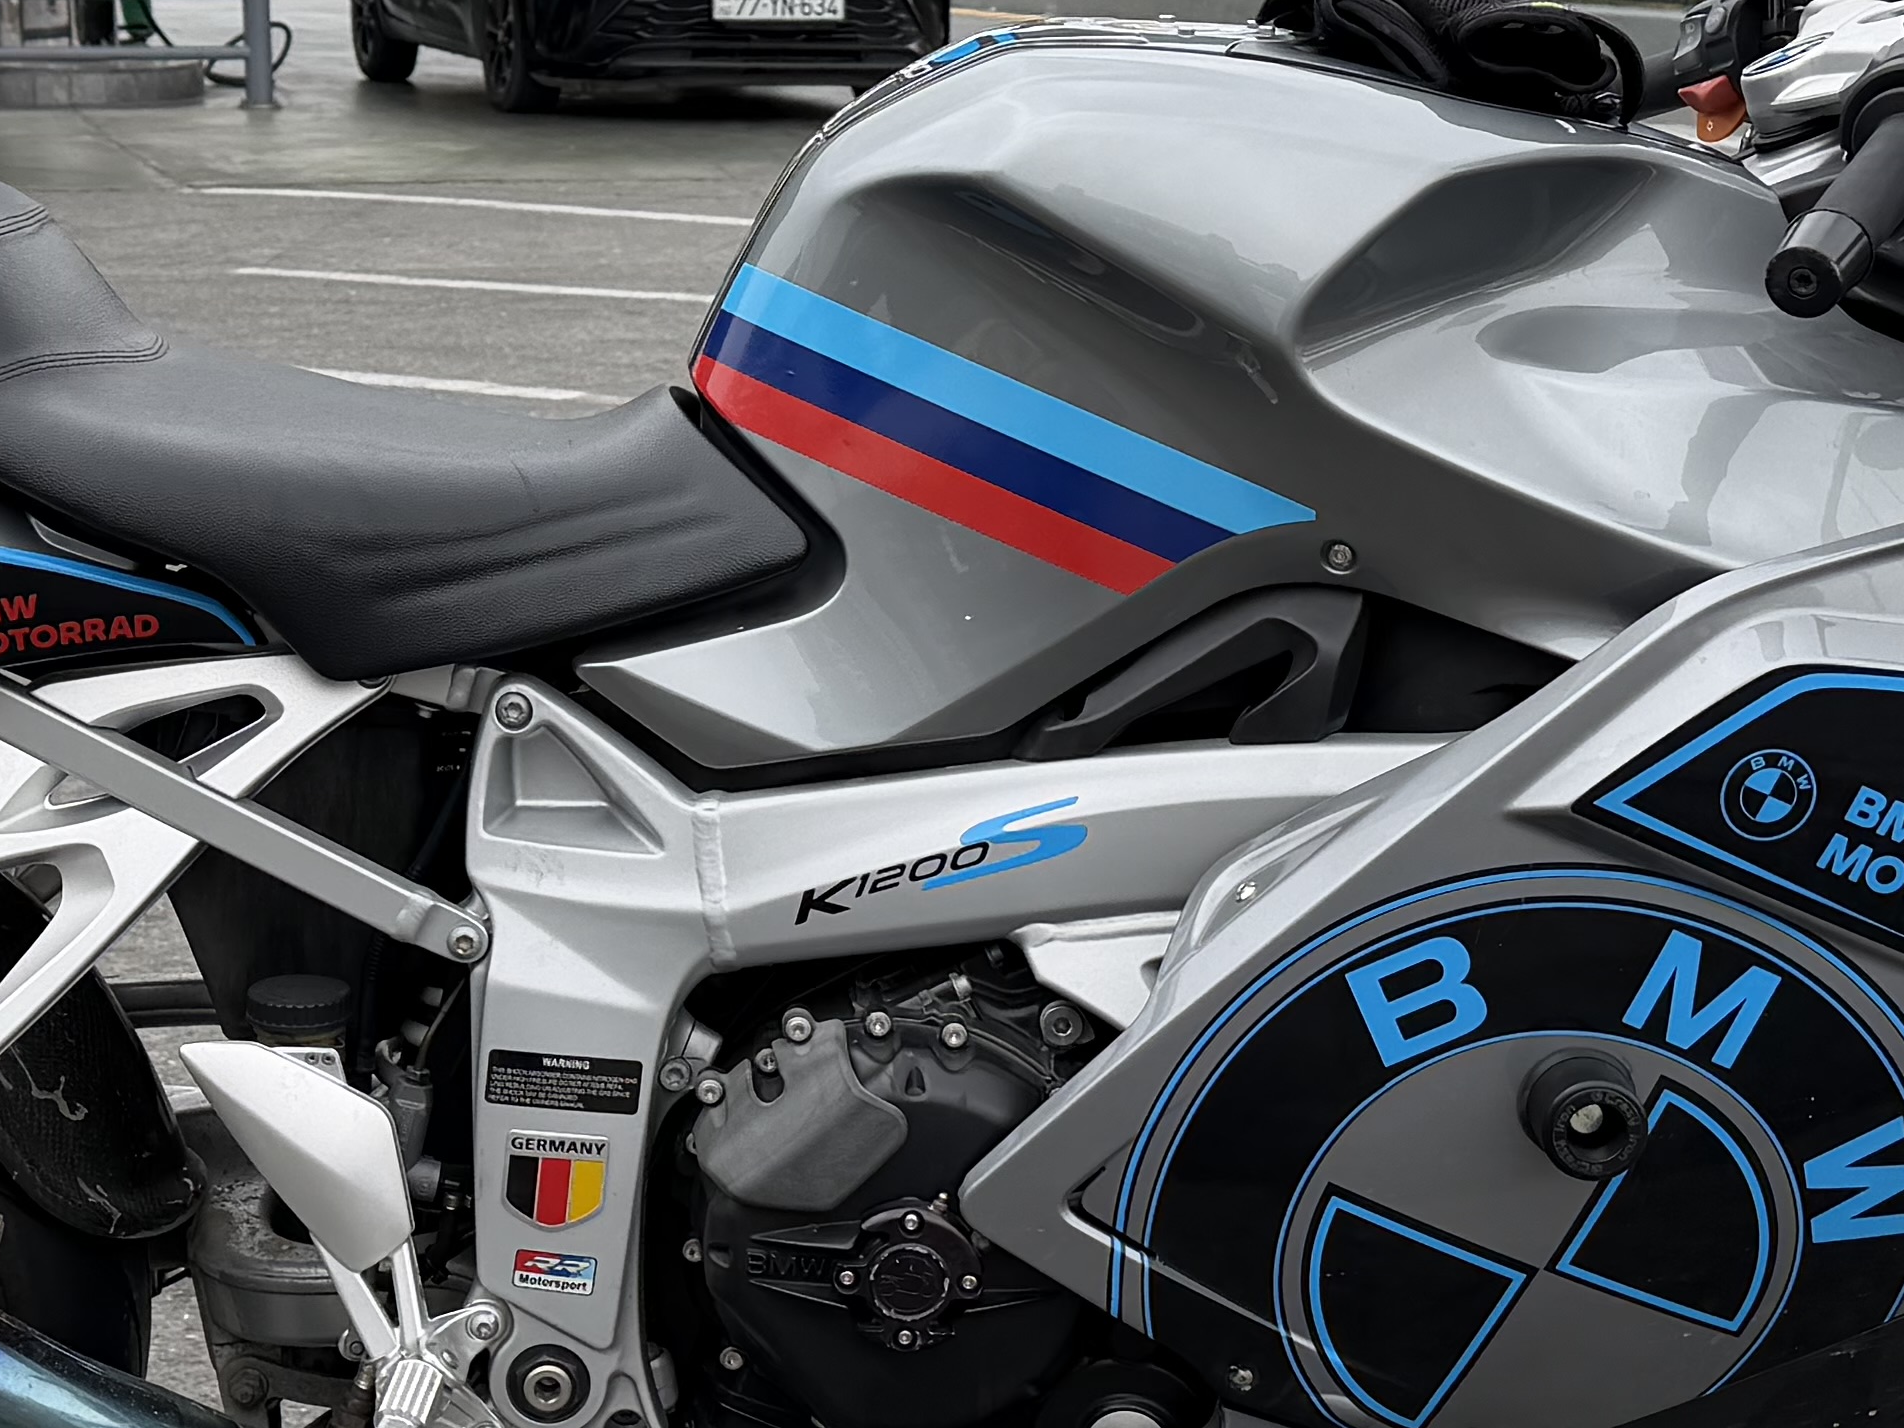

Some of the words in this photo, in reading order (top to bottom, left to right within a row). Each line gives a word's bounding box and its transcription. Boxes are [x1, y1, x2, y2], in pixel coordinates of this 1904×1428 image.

[1750, 755, 1813, 791] BMW
[542, 1056, 591, 1071] WARNING
[510, 1136, 607, 1156] GERMANY
[746, 1248, 826, 1275] BMW
[518, 1273, 588, 1292] Motorsport
